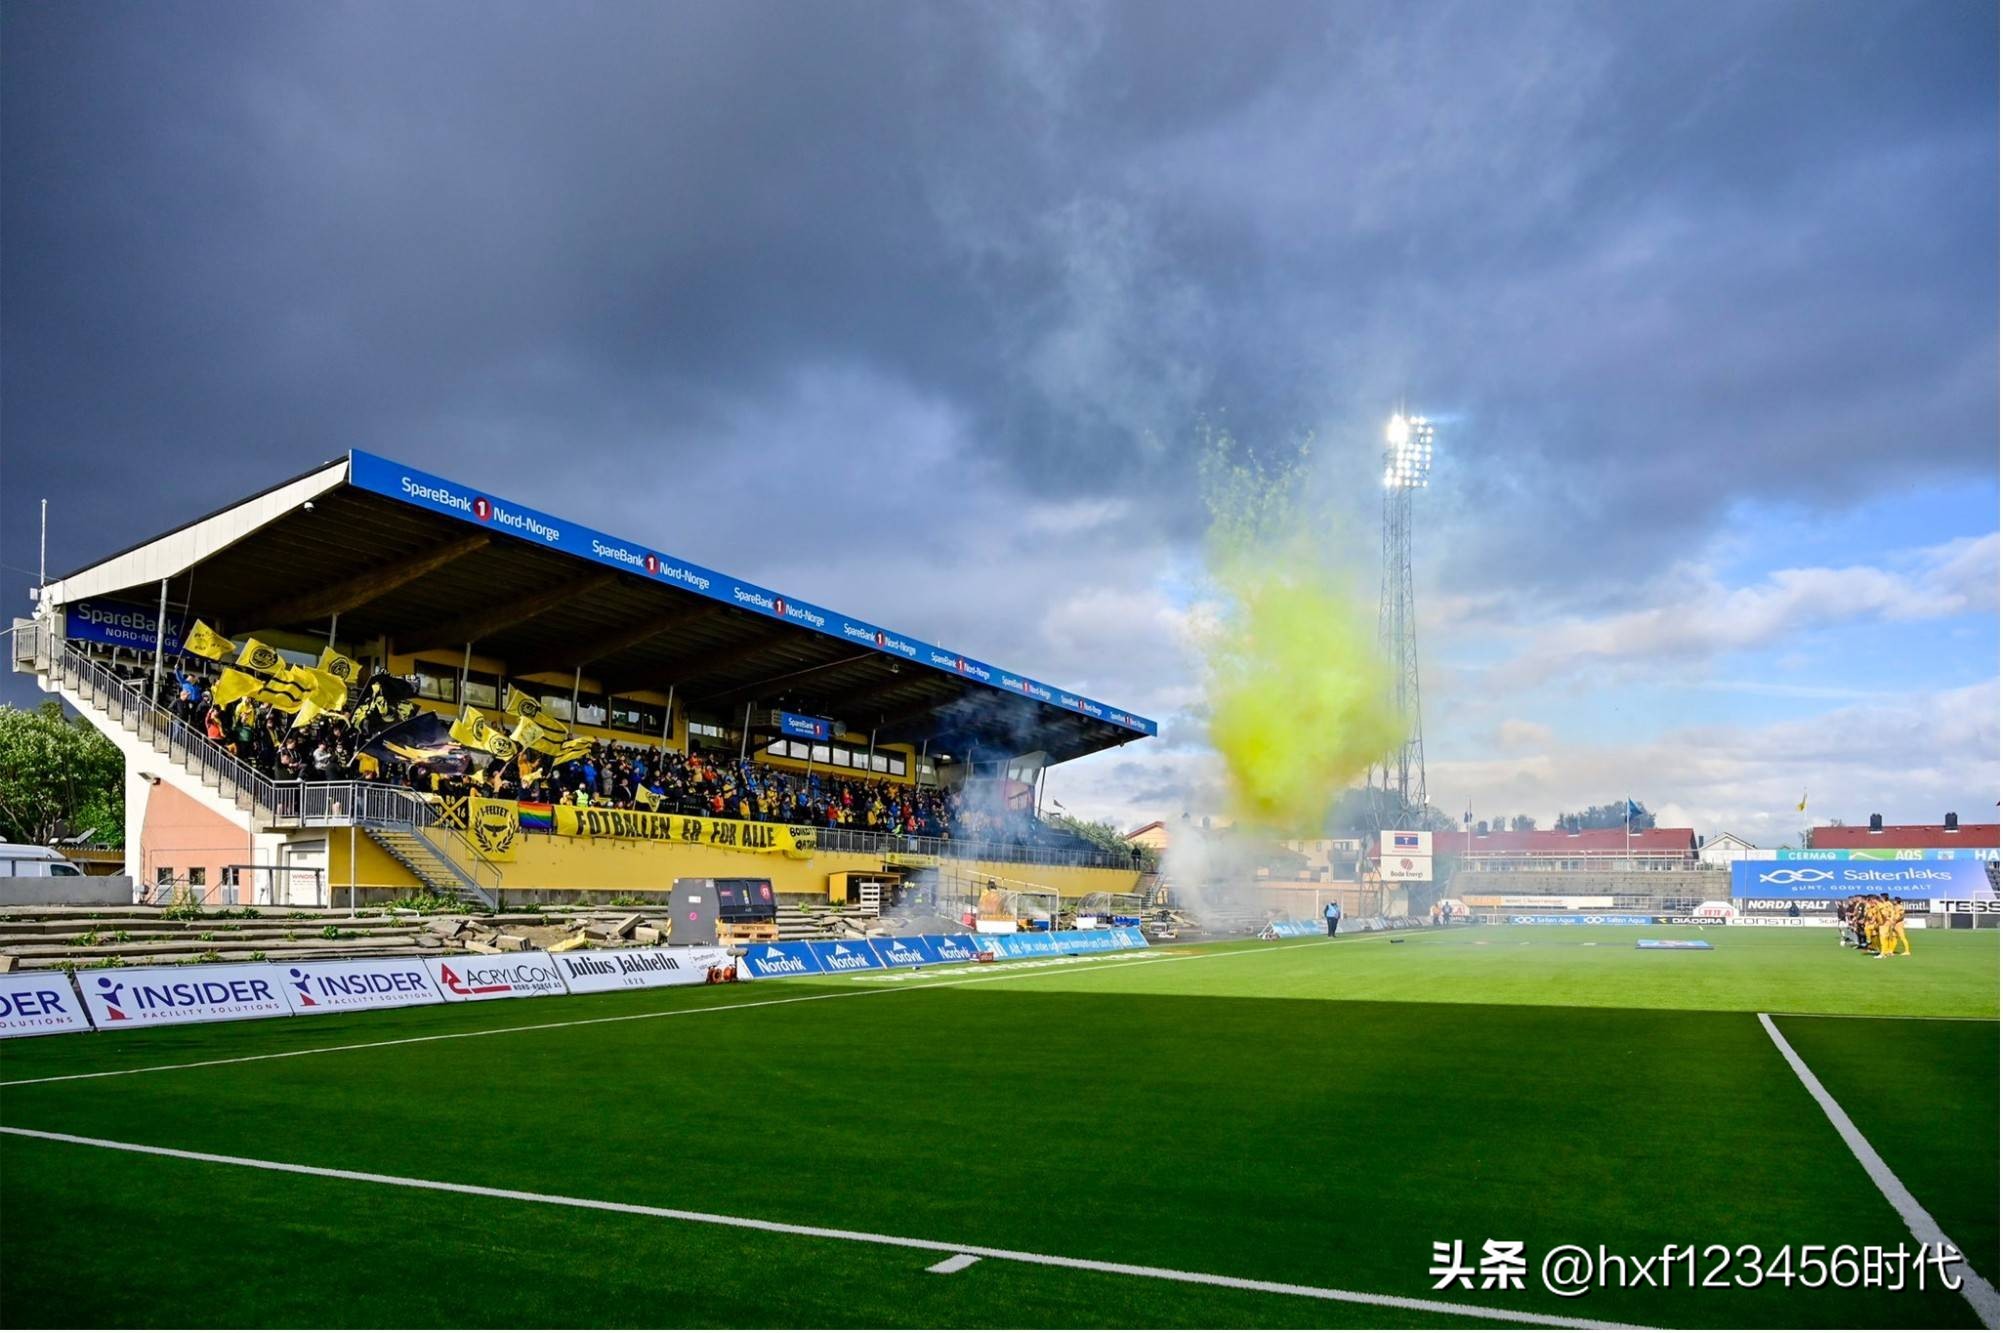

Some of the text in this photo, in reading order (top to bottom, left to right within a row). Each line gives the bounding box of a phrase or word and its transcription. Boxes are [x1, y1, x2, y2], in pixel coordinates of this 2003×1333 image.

[402, 477, 472, 512] SpareBank
[494, 507, 560, 541] Nord-Norge
[592, 540, 644, 568] SpareBank
[660, 562, 709, 590] Nord-Norge
[734, 587, 774, 611] SpareBank
[786, 604, 825, 627] Nord-Norge
[78, 603, 178, 636] SpareBak
[105, 627, 179, 648] NORD-NOGE
[575, 810, 671, 840] FOTBALLEN
[682, 818, 702, 842] ER
[710, 821, 737, 846] FOR
[742, 823, 777, 848] ALLE
[1788, 851, 1837, 860] CERMAQ
[1843, 867, 1953, 881] Saltenlaks
[826, 953, 870, 969] Nordvik
[886, 949, 925, 963] Nordvik
[938, 946, 970, 959] Nordvik
[563, 956, 616, 979] Julius
[614, 953, 680, 976] Jakhelln
[755, 956, 806, 973] Nordvik
[132, 979, 274, 1009] INSIDER
[317, 972, 428, 997] INSIDER
[328, 992, 433, 1005] FACILITY SOLUTIONS
[142, 1003, 280, 1019] FACILITY SOLUTIONS
